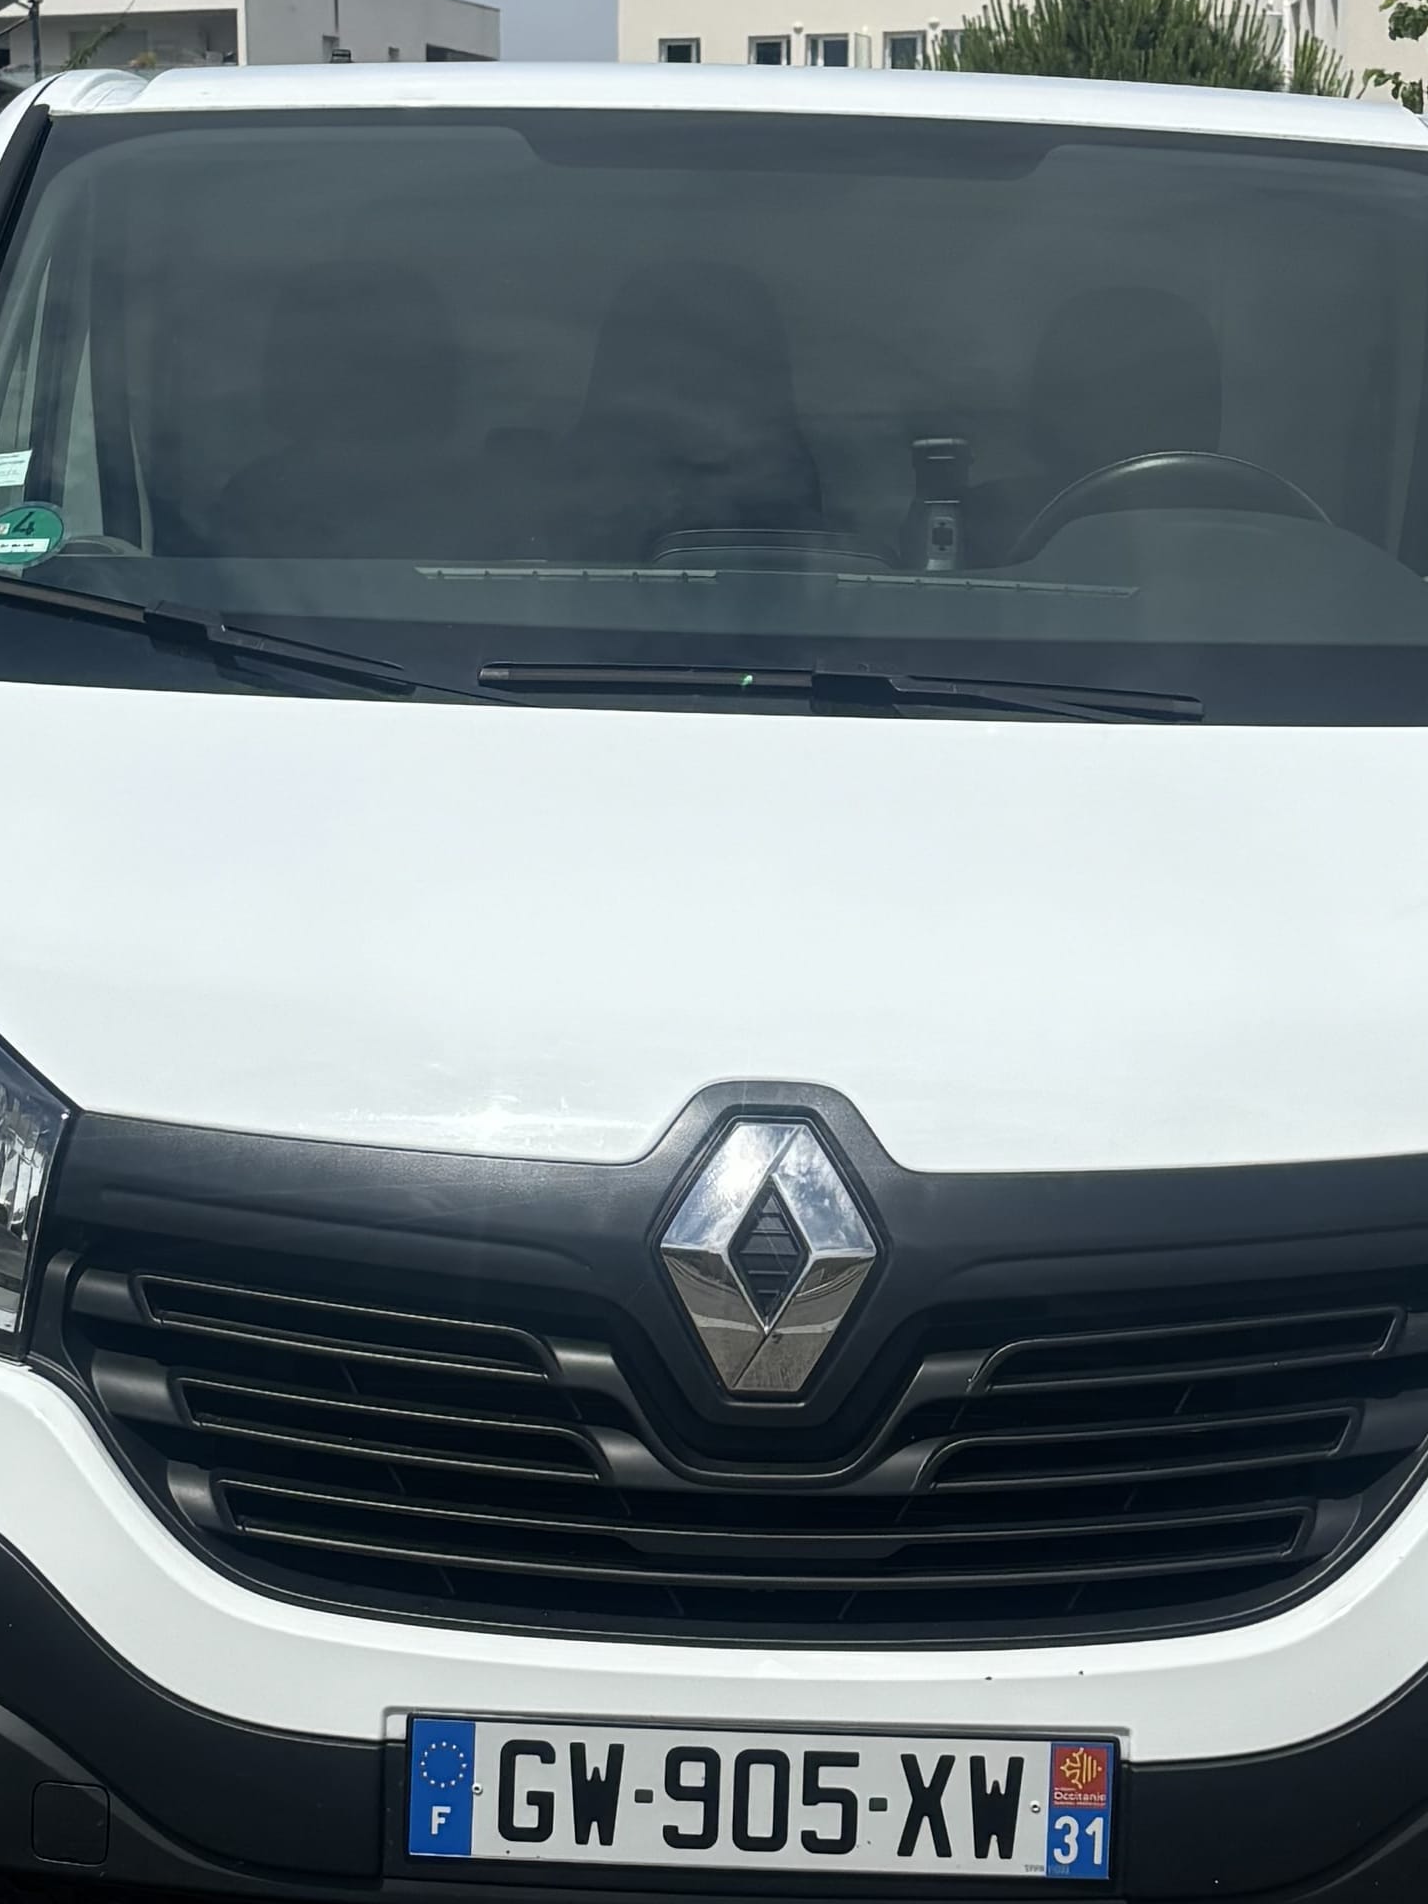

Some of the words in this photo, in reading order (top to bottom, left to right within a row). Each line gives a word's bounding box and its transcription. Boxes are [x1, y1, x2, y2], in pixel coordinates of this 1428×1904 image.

[12, 511, 36, 536] 4
[498, 1739, 1024, 1859] GW-905-XW
[430, 1806, 451, 1835] F
[1053, 1815, 1104, 1865] 31
